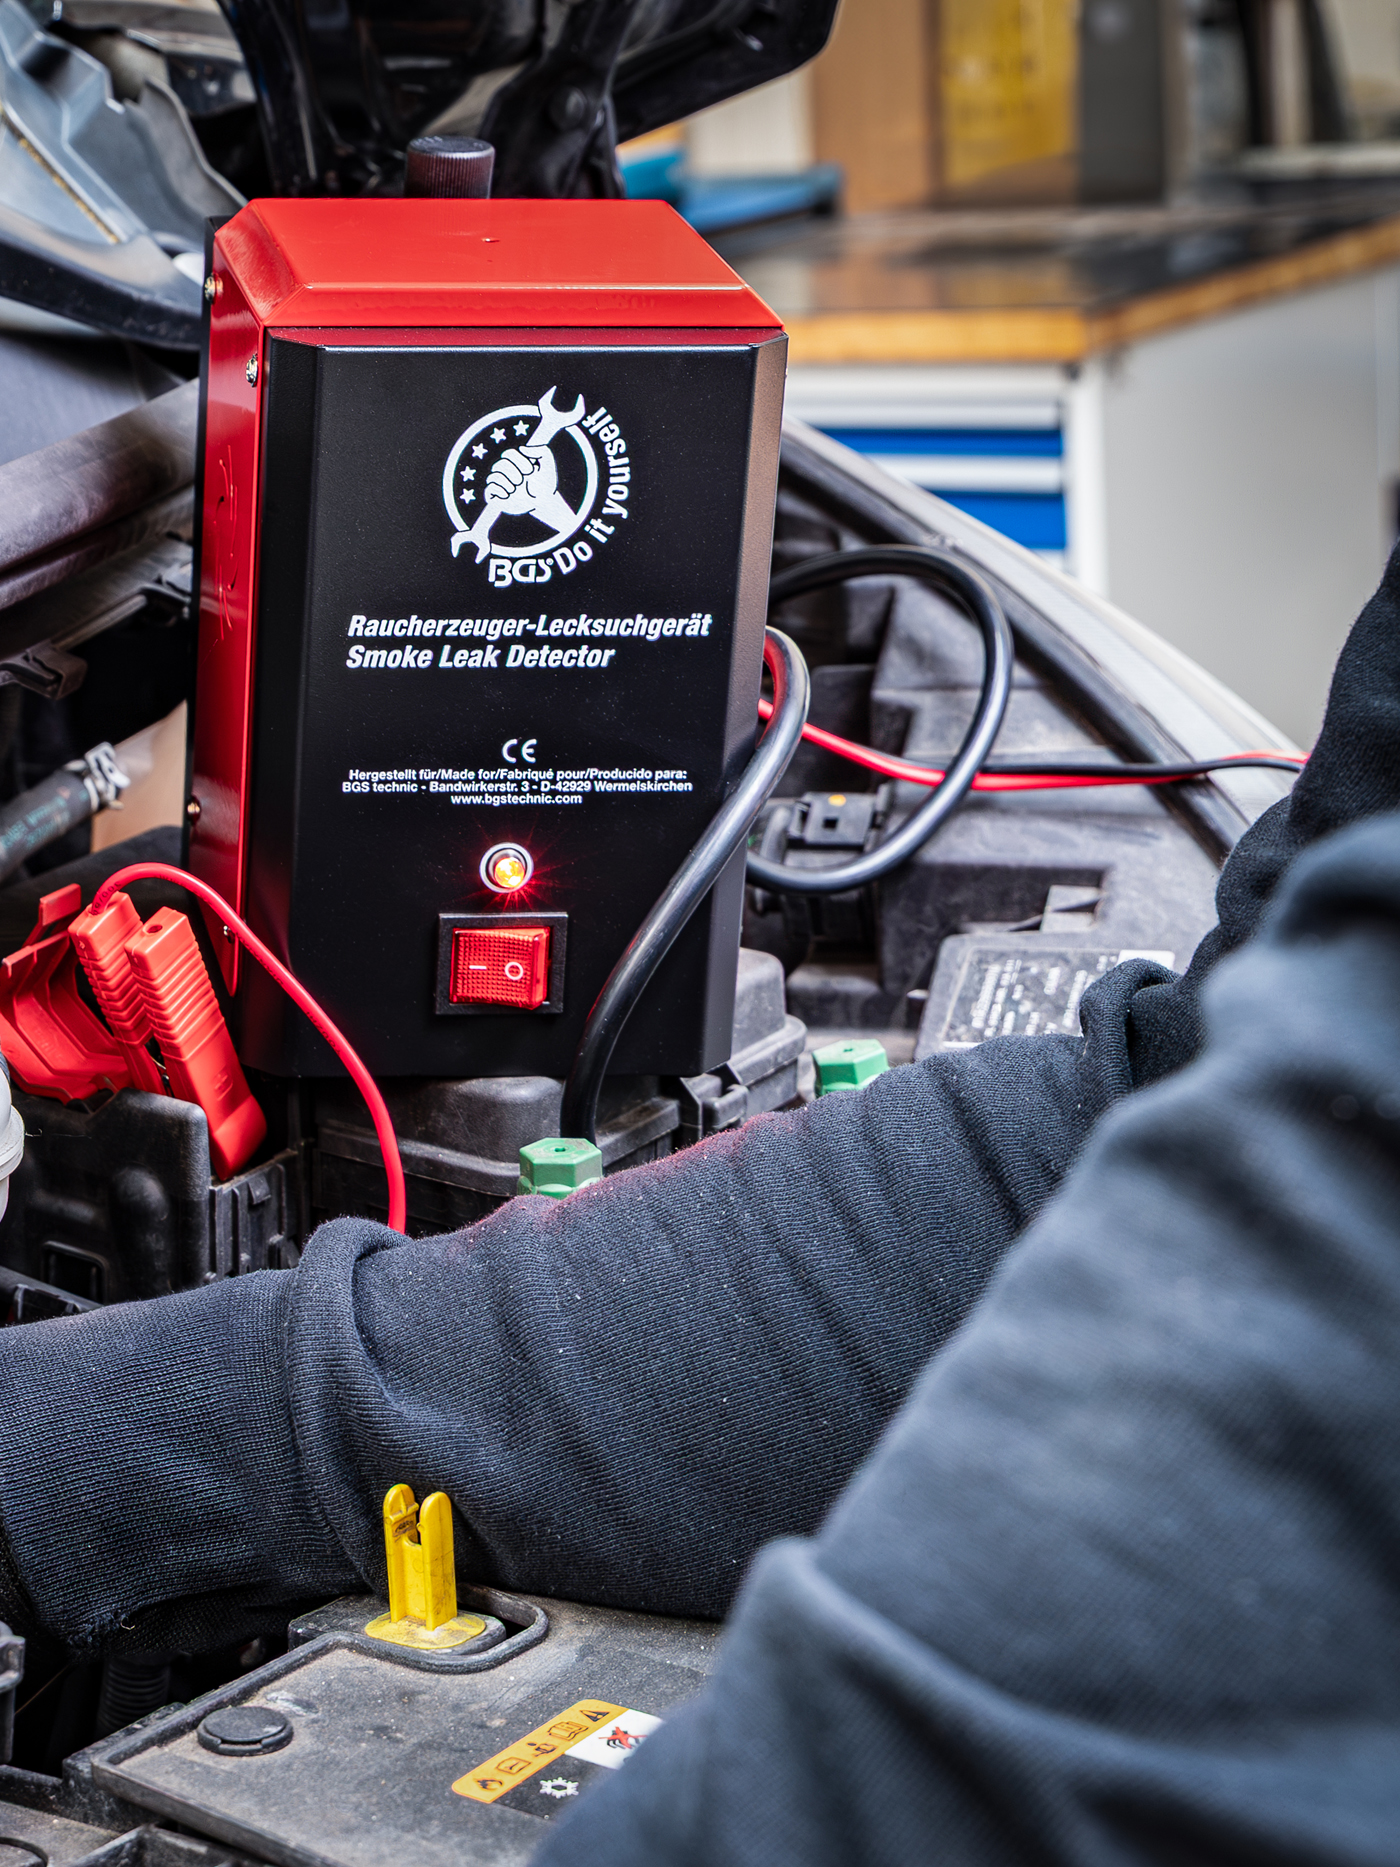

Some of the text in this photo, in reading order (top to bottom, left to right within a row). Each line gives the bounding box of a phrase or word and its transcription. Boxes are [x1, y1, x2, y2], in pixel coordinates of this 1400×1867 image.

[581, 406, 631, 519] yourself
[584, 518, 615, 543] it
[552, 541, 593, 575] Do
[347, 612, 713, 642] Raucherzeuger-Lecksuchgerät
[346, 644, 616, 669] Smoke Leak Detector
[501, 738, 538, 764] CE
[342, 781, 370, 793] BGS
[372, 781, 418, 793] technic
[429, 780, 519, 793] Bandwirkerstr.
[520, 781, 530, 792] 3
[540, 780, 592, 792] D-42929
[593, 780, 694, 792] Wermelskirchen
[349, 768, 687, 782] Hergestellt für/Made for/Fabriqué pour/Producido para:
[450, 793, 583, 807] www.bgstechnic.com
